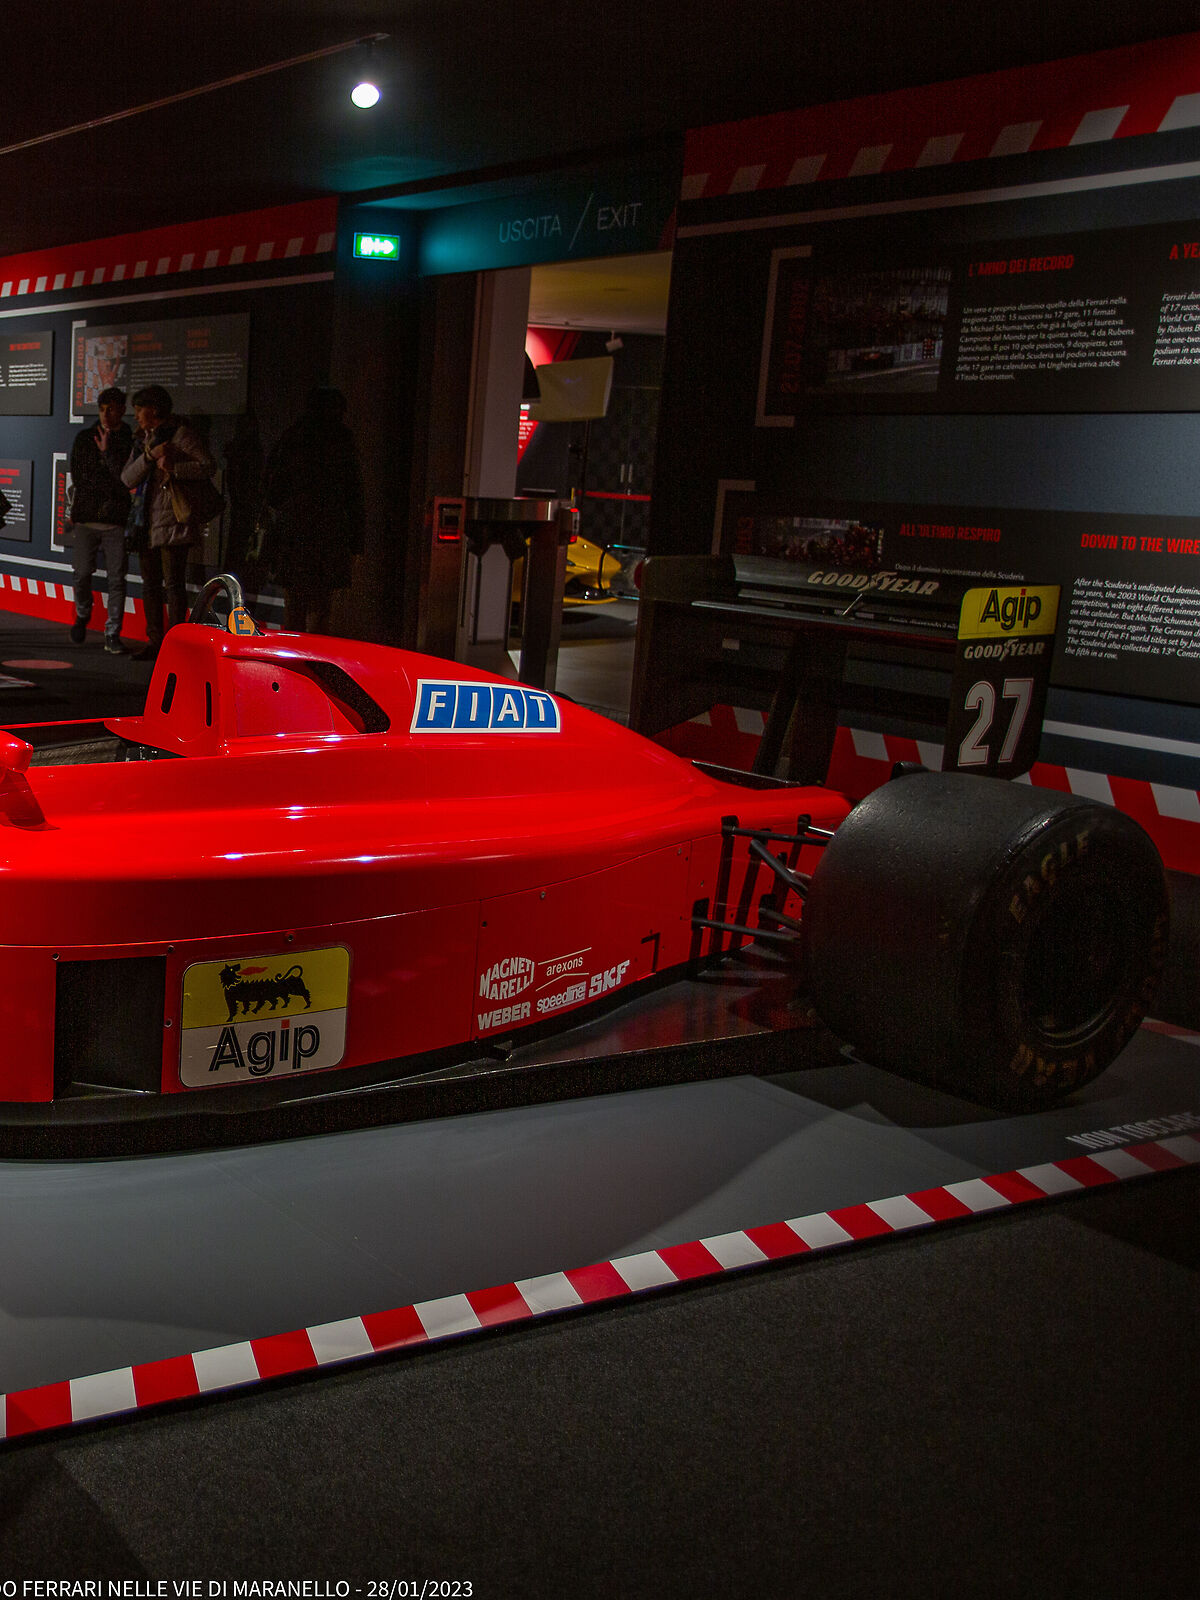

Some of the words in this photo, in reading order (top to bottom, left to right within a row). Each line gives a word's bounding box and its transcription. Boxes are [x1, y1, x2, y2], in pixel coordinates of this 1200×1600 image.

[500, 214, 562, 243] USCITA
[597, 203, 642, 231] EXIT
[1169, 244, 1178, 260] A
[1184, 242, 1200, 259] YE
[1029, 254, 1075, 272] RECORD
[1080, 533, 1118, 549] DOWN
[1121, 535, 1137, 551] TO
[1140, 537, 1164, 553] THE
[1167, 538, 1200, 555] WIRE
[806, 569, 939, 597] GOODYEAR
[1074, 578, 1090, 588] After
[1103, 580, 1136, 590] Scuderia's
[1137, 583, 1174, 595] undisputed
[1072, 598, 1109, 610] competition,
[1110, 601, 1125, 610] with
[1126, 603, 1142, 613] eight
[1143, 604, 1172, 616] different
[1073, 588, 1084, 596] two
[1084, 591, 1103, 600] years,
[1104, 591, 1115, 599] the
[1116, 592, 1136, 600] 2003
[1137, 594, 1158, 602] World
[1160, 595, 1200, 607] Champions
[978, 588, 1042, 630] Agip
[1079, 608, 1089, 616] the
[1090, 609, 1120, 619] calendar.
[1120, 612, 1133, 620] But
[1134, 613, 1162, 622] Michael
[234, 610, 251, 635] E
[1069, 618, 1094, 629] emerged
[1095, 620, 1125, 630] victorious
[1126, 623, 1148, 634] again.
[1149, 626, 1162, 634] The
[1163, 627, 1192, 637] German
[1193, 630, 1200, 638] d
[1067, 636, 1078, 644] The
[1079, 638, 1106, 648] Scuderia
[1107, 641, 1120, 649] also
[1121, 642, 1149, 652] collected
[1150, 646, 1160, 654] its
[1176, 648, 1200, 658] Constr
[1068, 627, 1077, 635] the
[1078, 628, 1098, 637] record
[1099, 630, 1106, 639] of
[1119, 632, 1128, 640] F1
[1129, 633, 1149, 642] world
[1150, 635, 1167, 643] titles
[1168, 636, 1178, 644] set
[1179, 637, 1188, 647] by
[963, 638, 1046, 663] GOODYEAR
[1065, 646, 1074, 654] the
[1075, 648, 1089, 658] fifth
[1090, 649, 1096, 657] in
[426, 690, 548, 722] FIAT
[957, 677, 1035, 767] 27
[546, 955, 604, 977] arexons
[588, 959, 631, 998] SKF
[537, 980, 587, 1014] speedline
[477, 1001, 532, 1031] WEBER
[207, 1019, 321, 1077] Agip
[1064, 1129, 1131, 1150] NON
